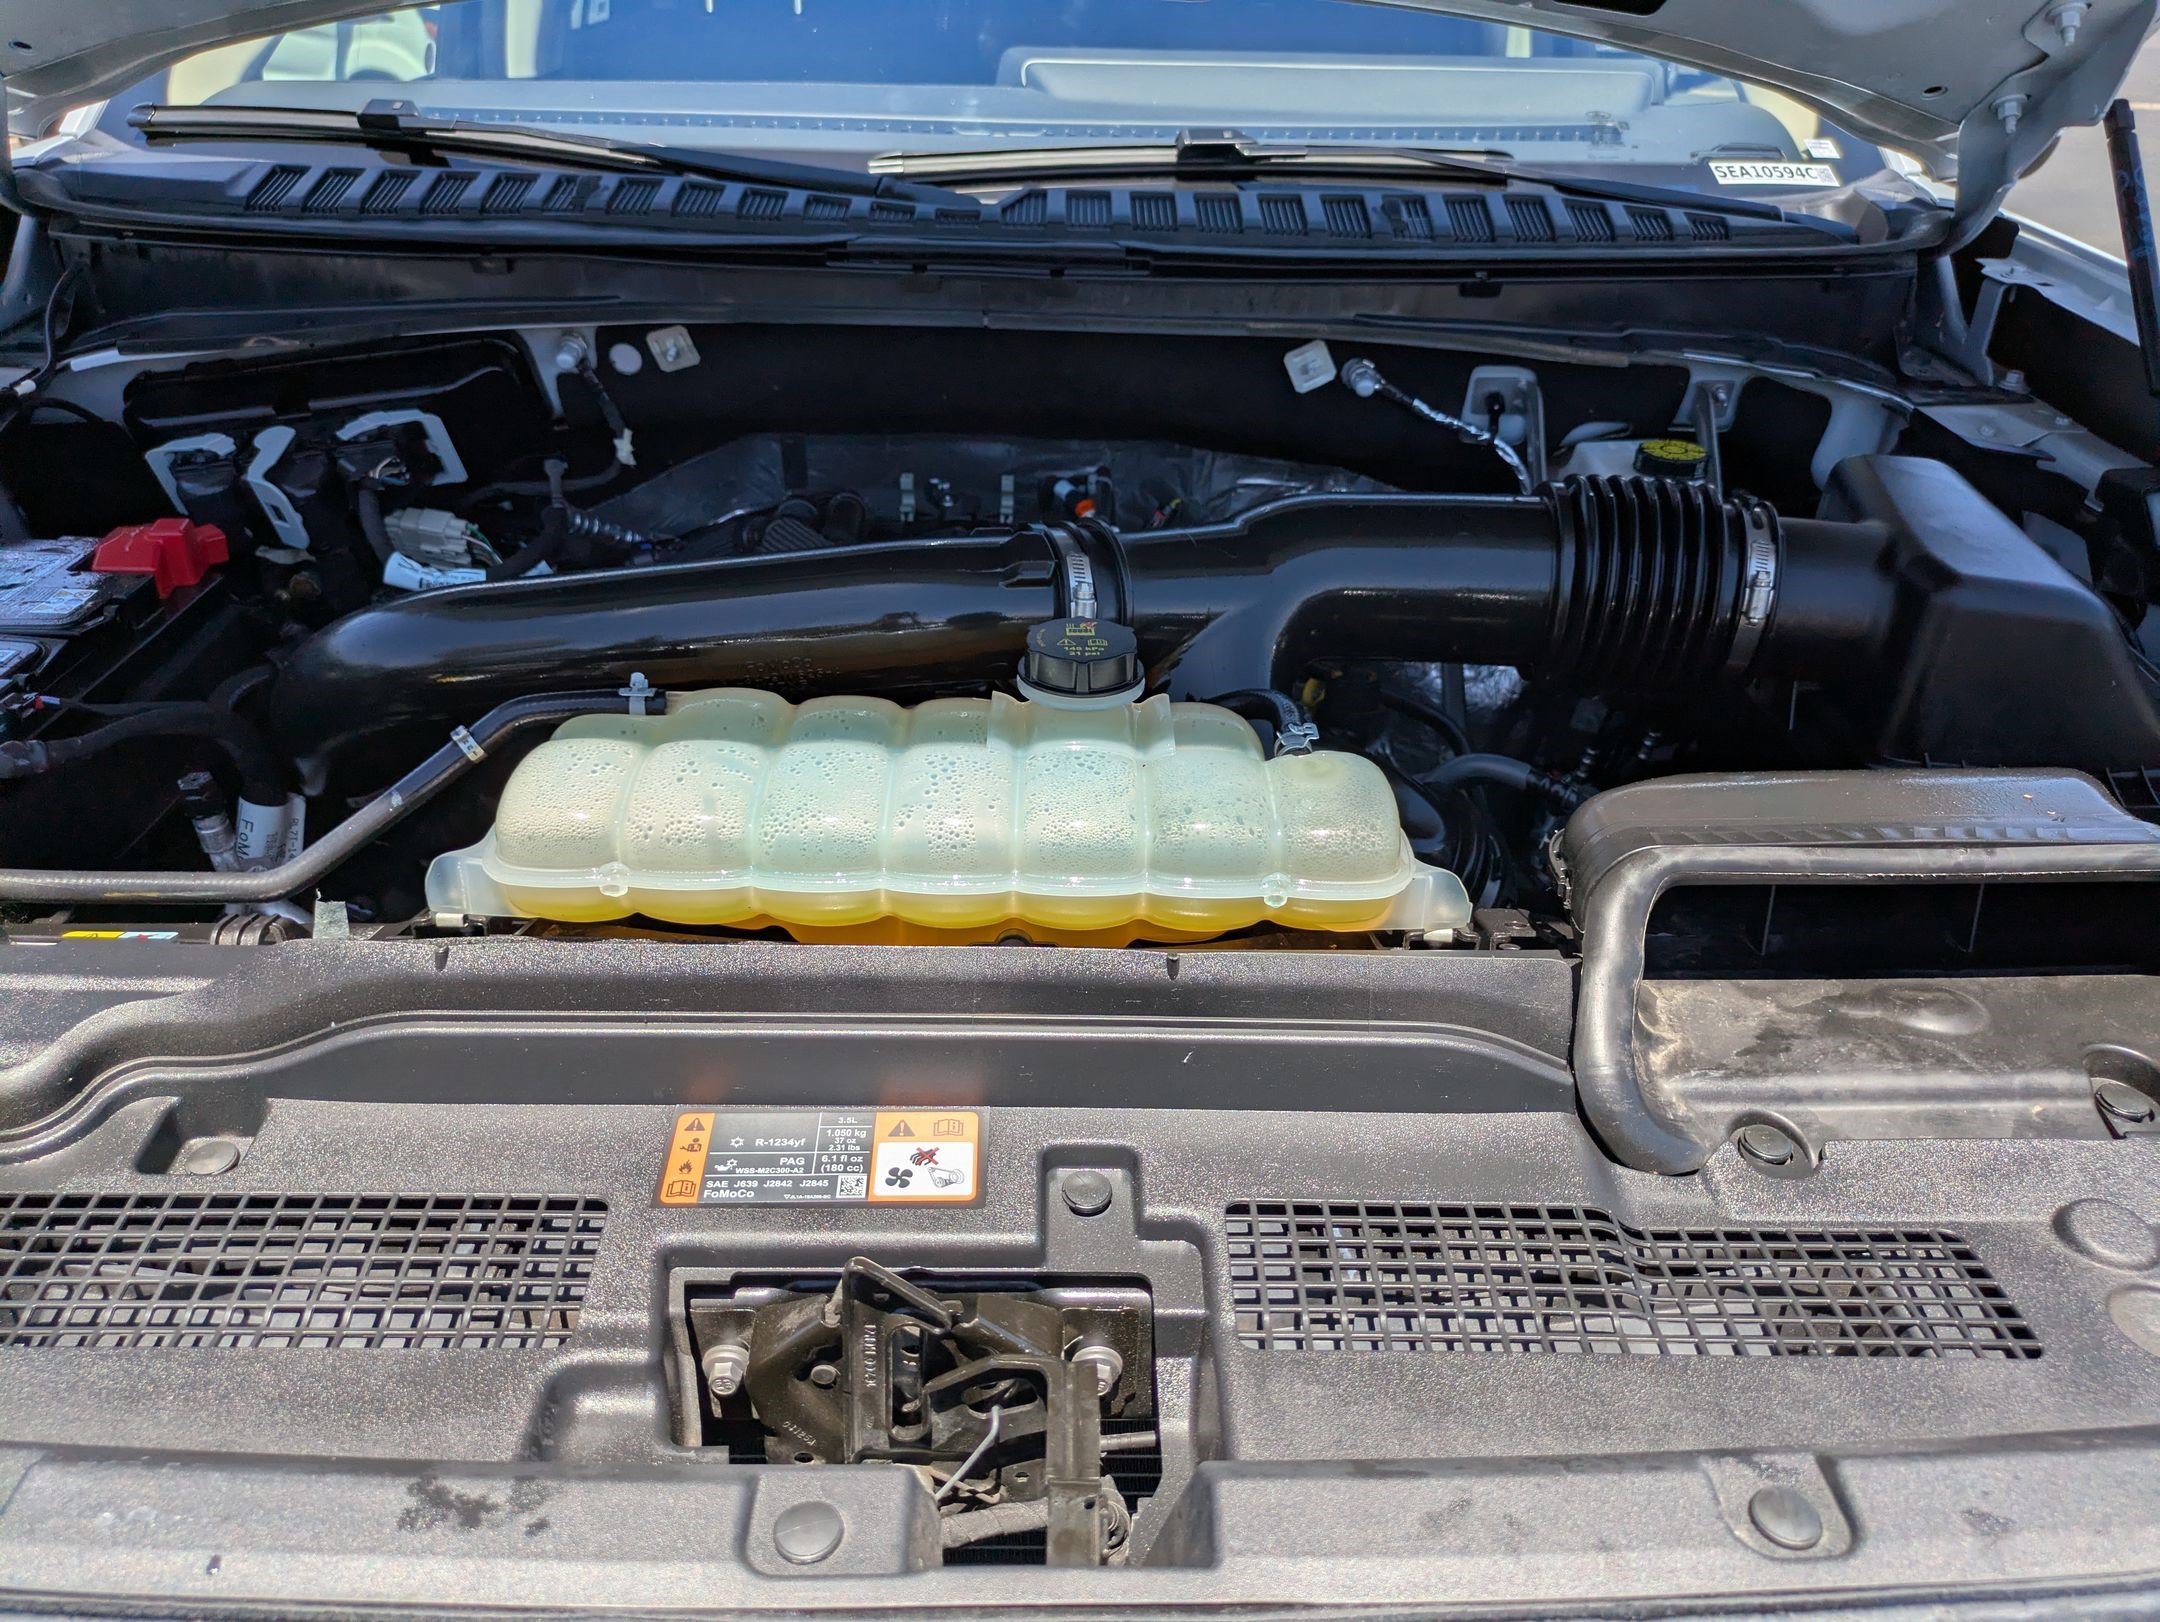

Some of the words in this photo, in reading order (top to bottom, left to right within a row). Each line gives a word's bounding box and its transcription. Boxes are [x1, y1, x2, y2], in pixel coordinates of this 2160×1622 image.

[1714, 165, 1818, 179] SEA10594C
[827, 1129, 852, 1137] 1.050
[854, 1129, 867, 1138] kg
[755, 1138, 806, 1147] R-1234yf
[779, 1157, 805, 1166] PAG
[820, 1164, 844, 1173] (180
[846, 1164, 864, 1173] cc)
[706, 1180, 729, 1188] SAE
[733, 1180, 758, 1188] J639
[763, 1180, 793, 1188] J2842
[799, 1179, 829, 1187] J2845
[703, 1189, 755, 1198] FoMoCo
